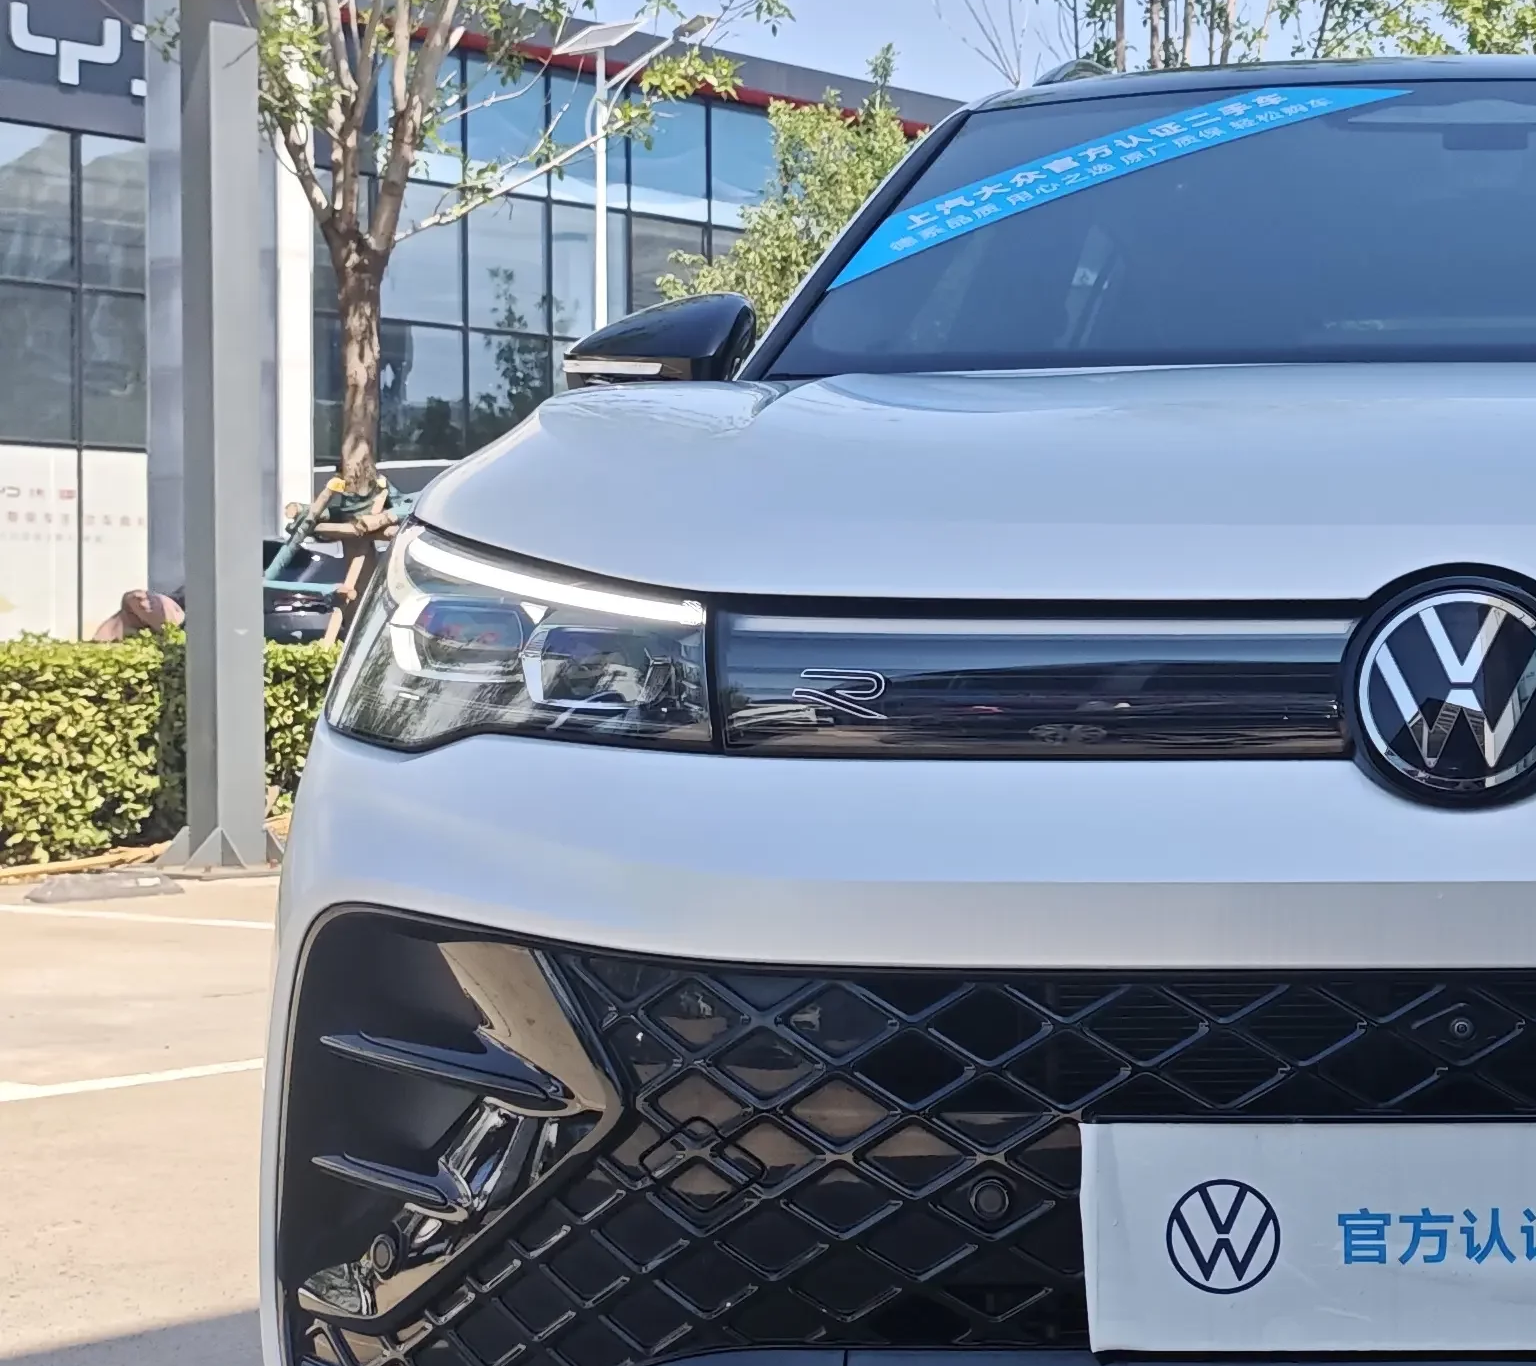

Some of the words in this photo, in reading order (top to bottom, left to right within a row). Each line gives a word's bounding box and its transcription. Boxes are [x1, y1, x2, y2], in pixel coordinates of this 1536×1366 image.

[907, 93, 1288, 231] 上汽大众官方认证二手车
[1006, 163, 1116, 206] 用心之选
[1120, 126, 1226, 166] 原厂质保
[1168, 1180, 1279, 1292] VW
